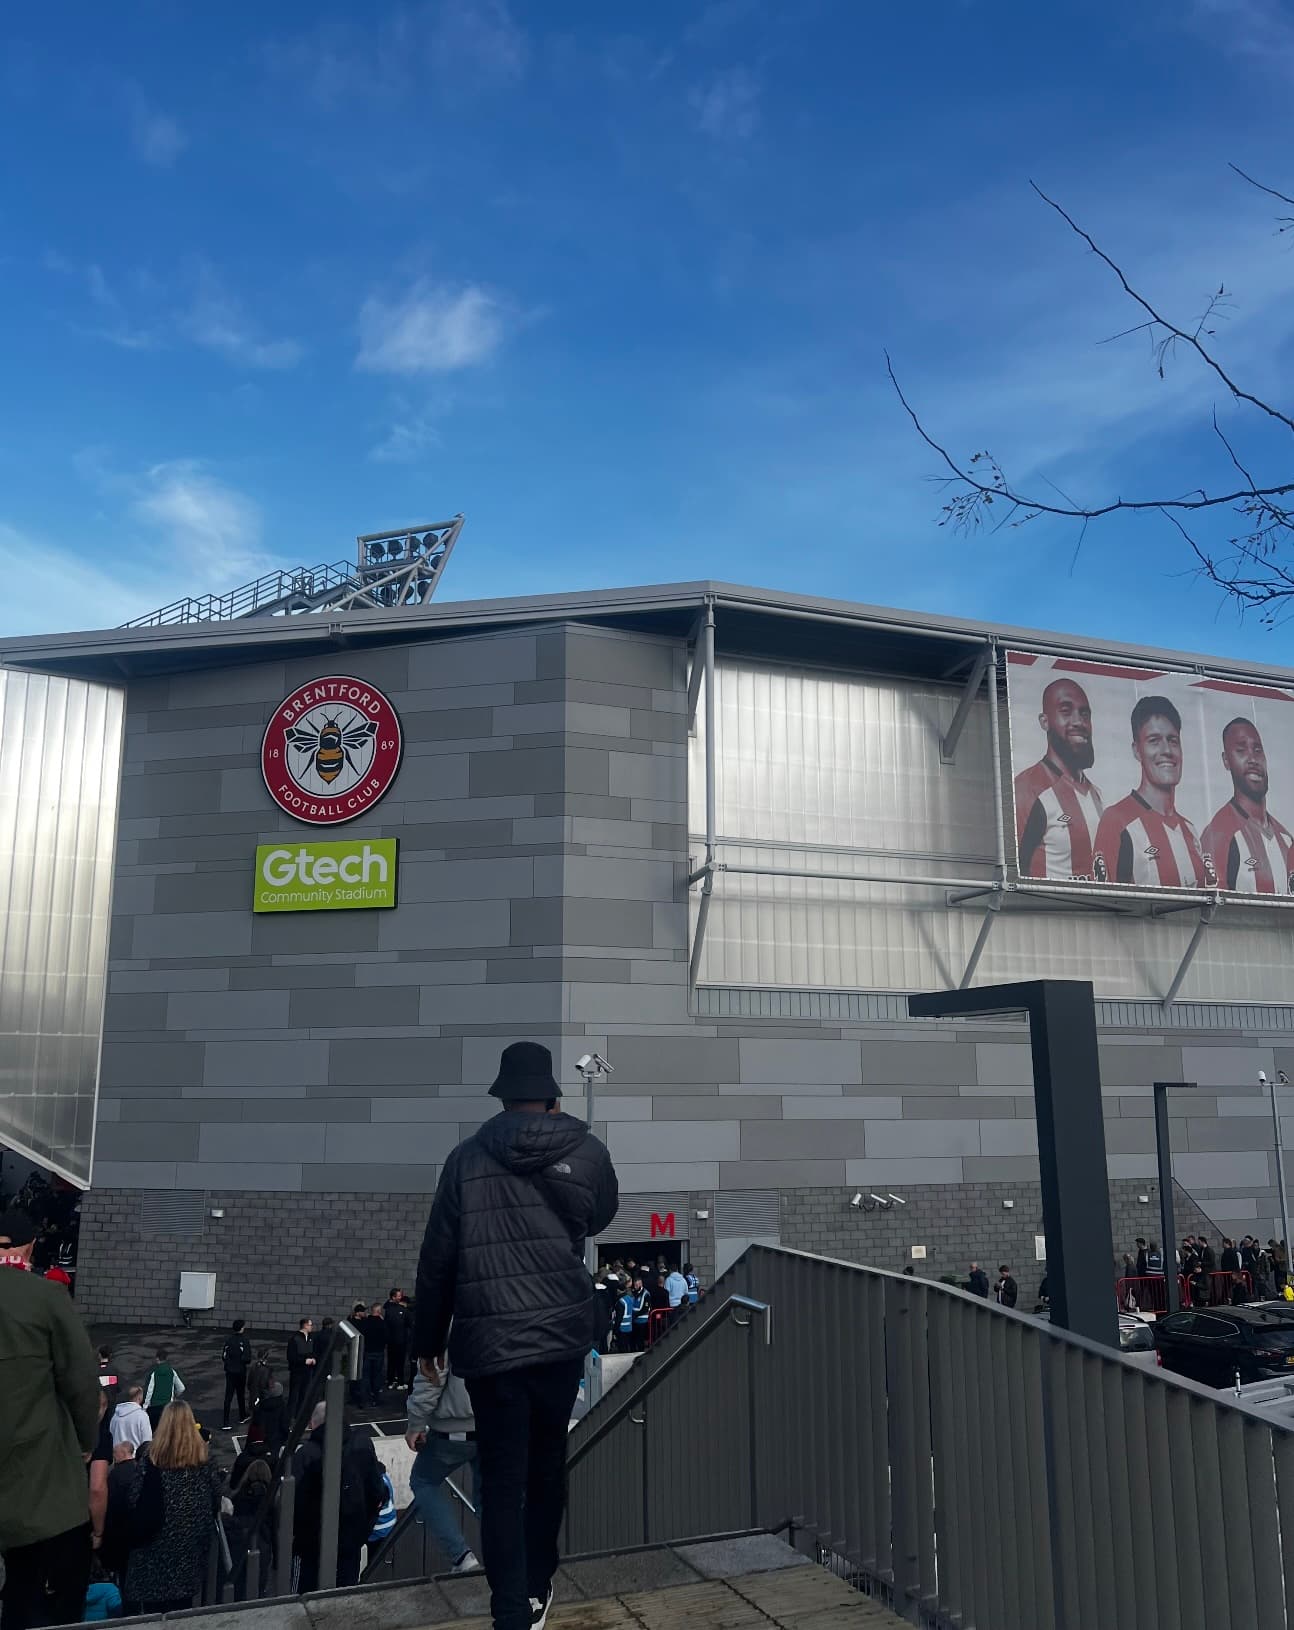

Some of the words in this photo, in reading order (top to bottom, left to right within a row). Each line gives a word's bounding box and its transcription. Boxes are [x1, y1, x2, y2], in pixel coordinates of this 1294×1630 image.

[282, 683, 381, 721] BRENTFORD
[269, 749, 279, 759] 18
[380, 740, 395, 751] 89
[278, 784, 344, 816] FOOTBALL
[347, 778, 380, 809] CLUB
[262, 845, 388, 887] Gtech
[260, 888, 333, 904] Community
[335, 886, 387, 900] Stadium
[650, 1211, 675, 1238] M
